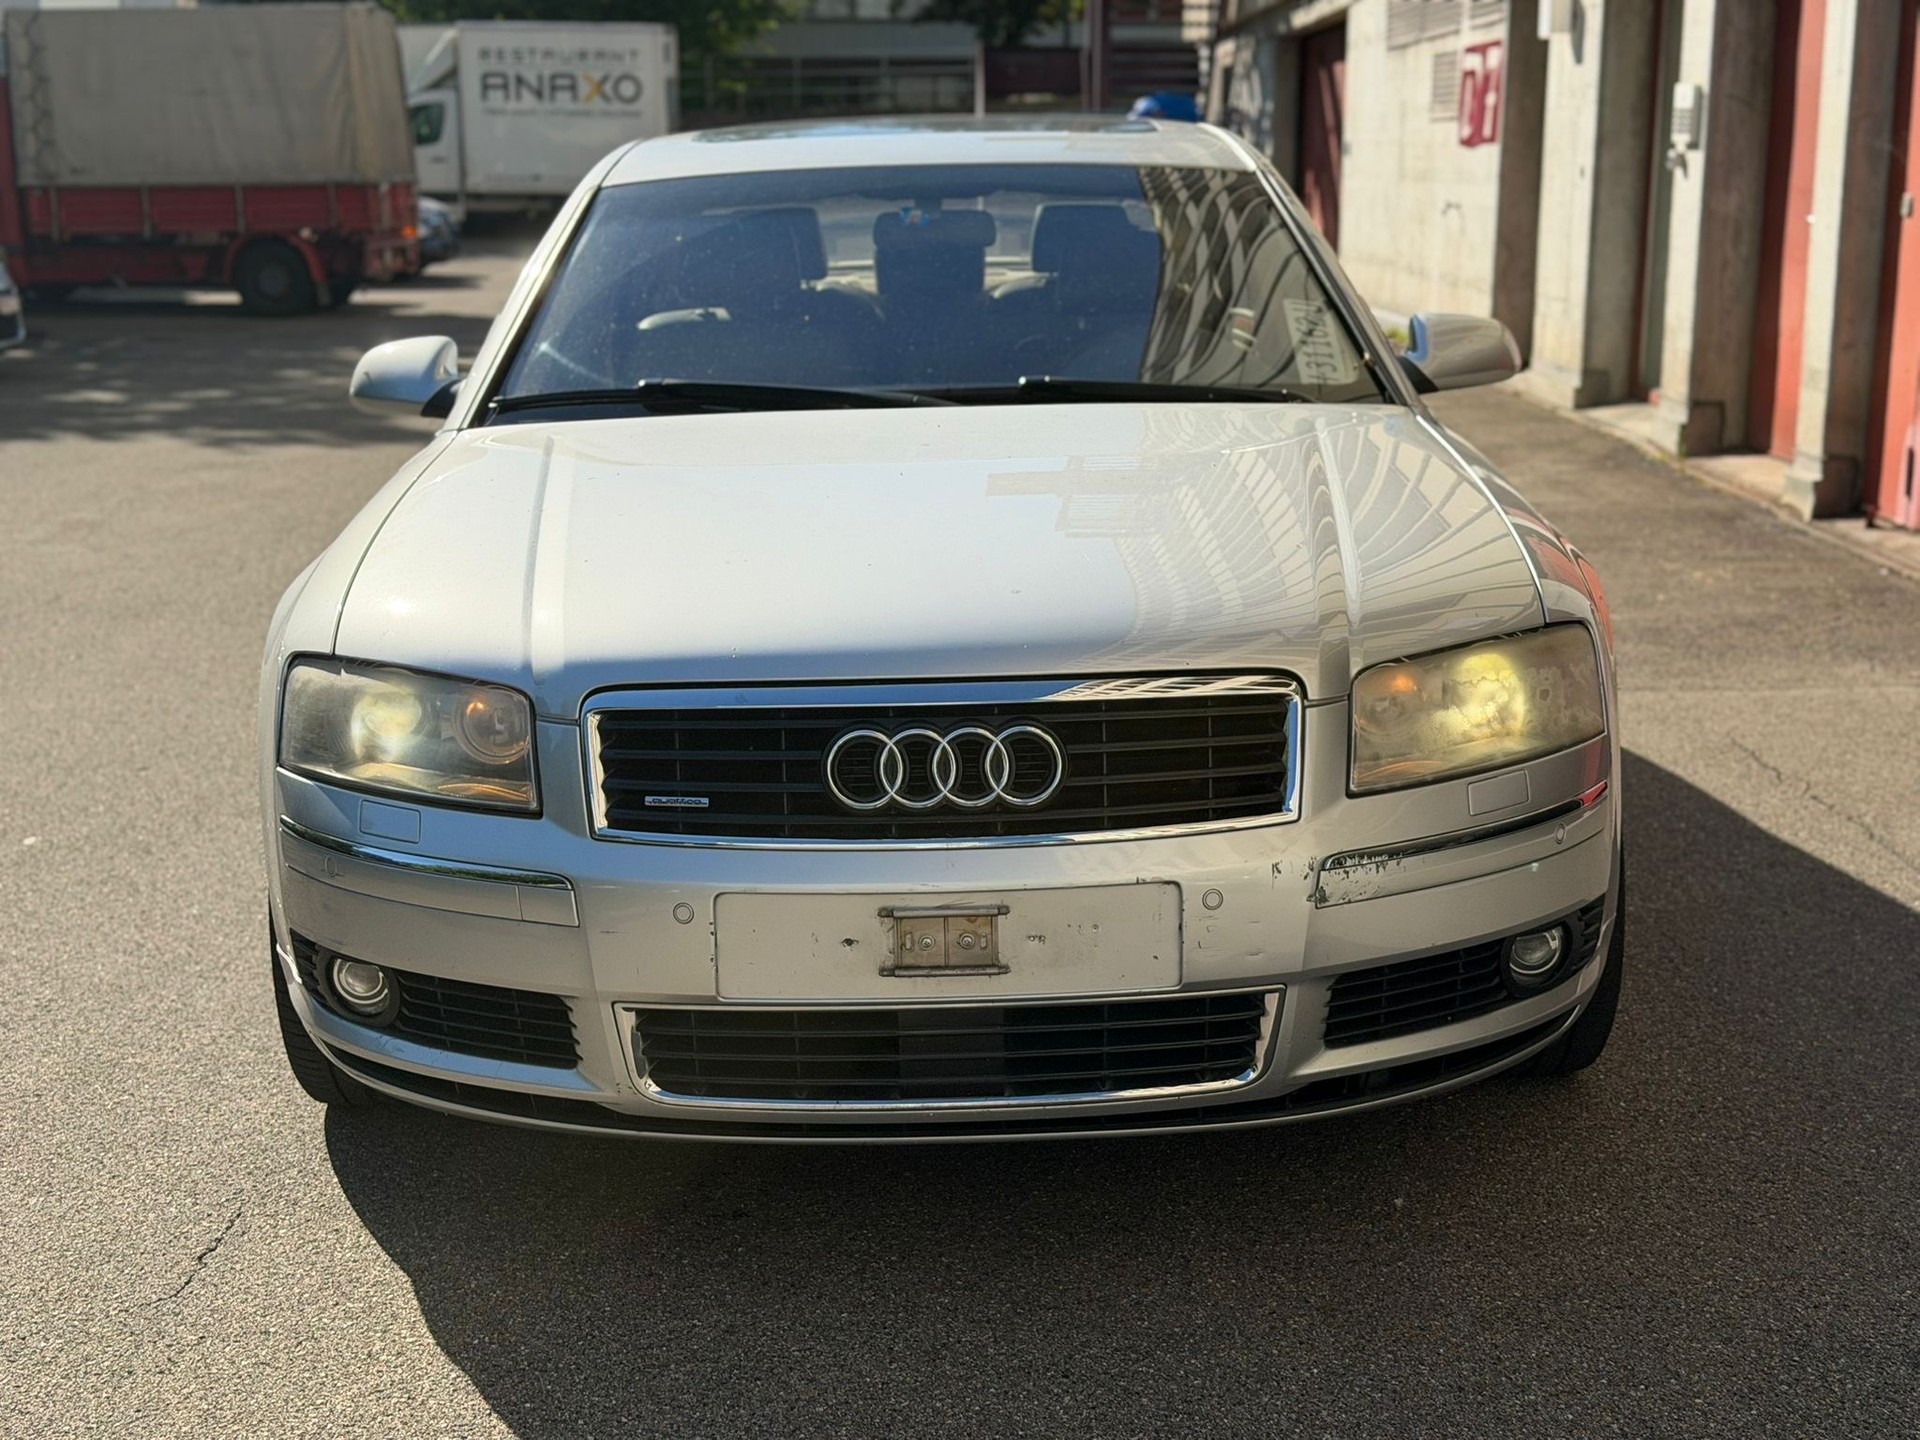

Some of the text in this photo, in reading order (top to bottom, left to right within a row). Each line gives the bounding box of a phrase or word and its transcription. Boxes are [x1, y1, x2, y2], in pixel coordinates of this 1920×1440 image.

[479, 48, 641, 65] RESTAURANT
[481, 72, 643, 105] ANAXO
[647, 797, 707, 806] quattro
